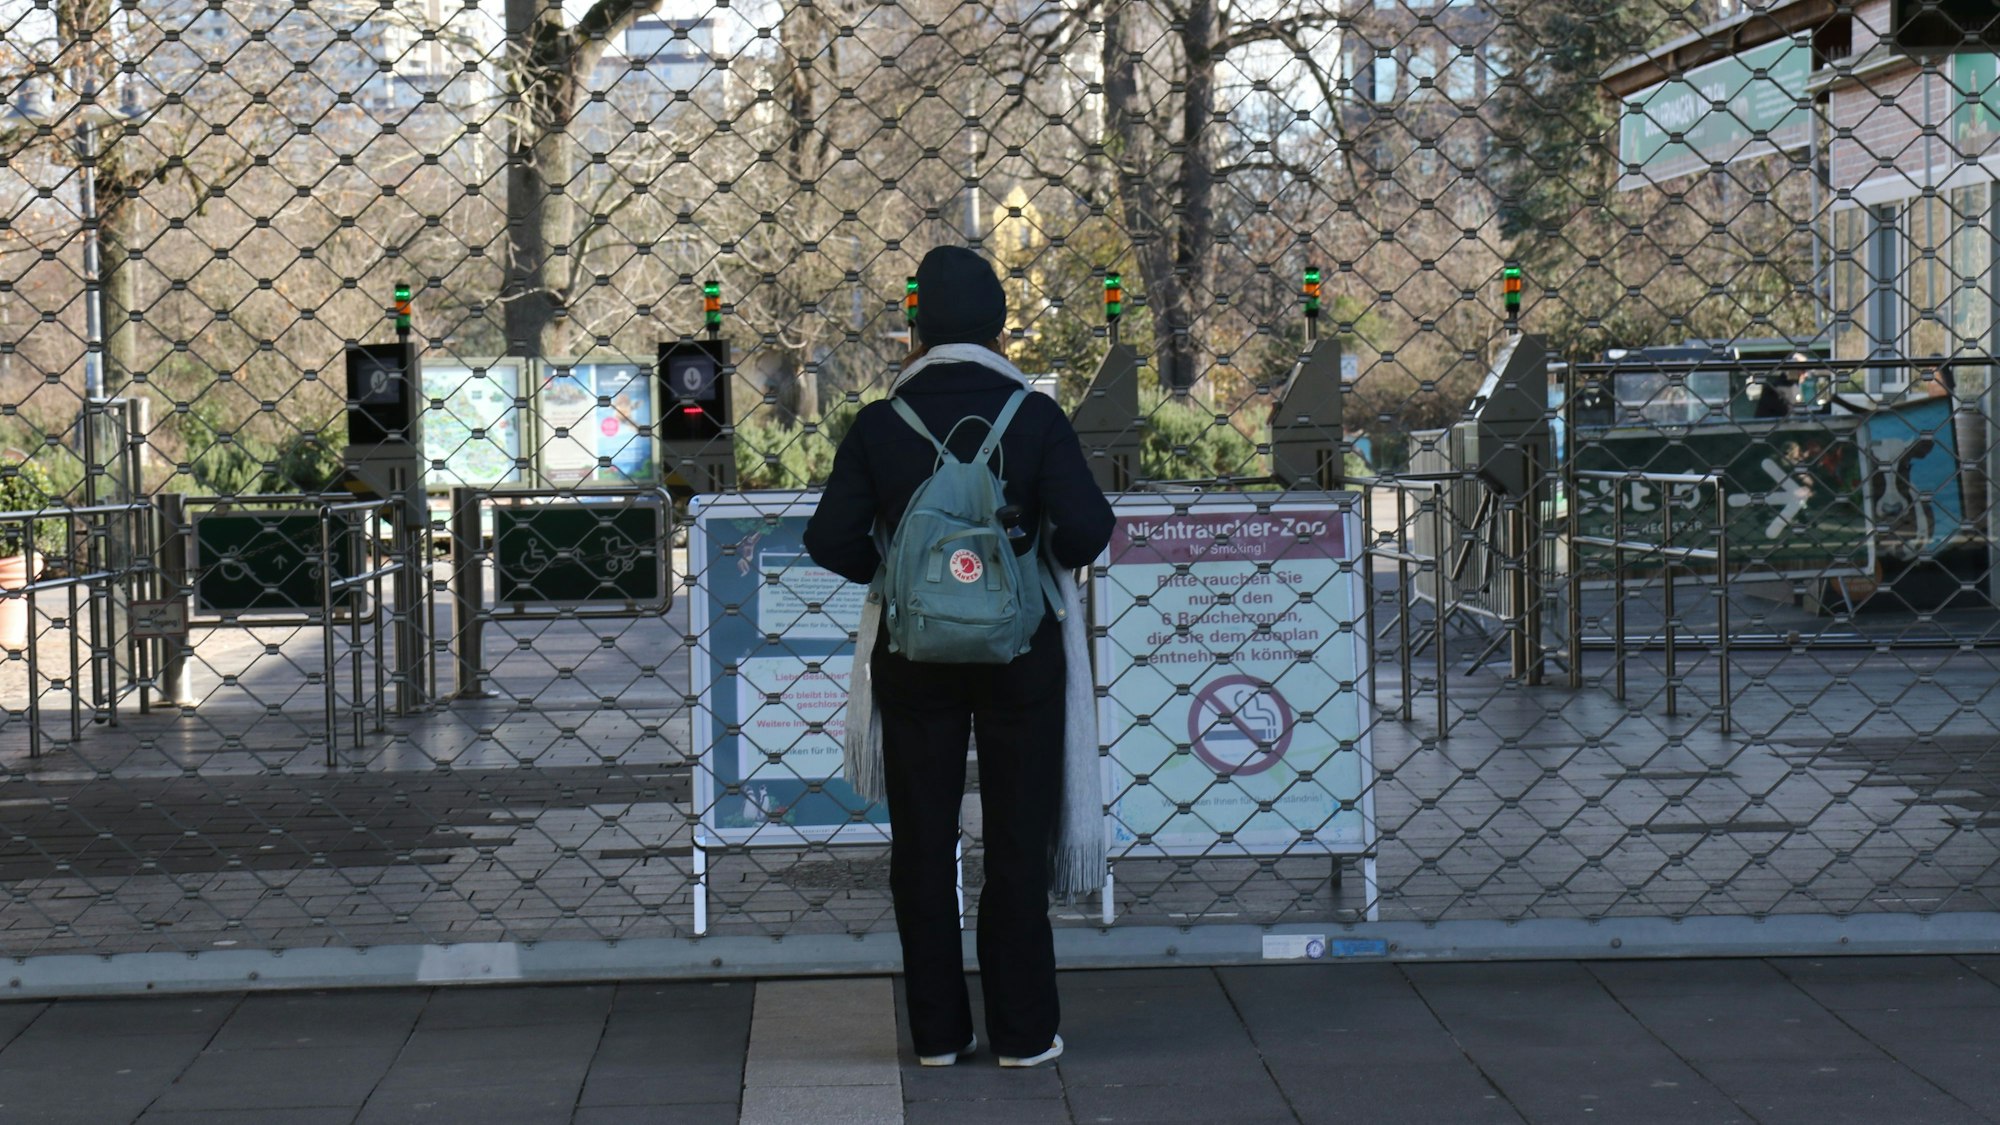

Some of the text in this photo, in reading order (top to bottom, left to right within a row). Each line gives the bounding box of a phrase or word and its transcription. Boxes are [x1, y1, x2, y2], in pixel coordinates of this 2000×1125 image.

[1127, 518, 1327, 541] Nichtraucher-Zoo
[1641, 520, 1703, 535] REGSTER
[1210, 542, 1267, 556] Smoking!
[1203, 571, 1271, 586] rauchen
[1277, 571, 1303, 584] Sie
[1189, 594, 1216, 606] nur
[1242, 593, 1273, 605] den
[1161, 610, 1303, 626] 6 Raucherzonen,
[1147, 628, 1319, 645] die Sie dem Zooplan
[1151, 648, 1319, 664] entnehen könne.
